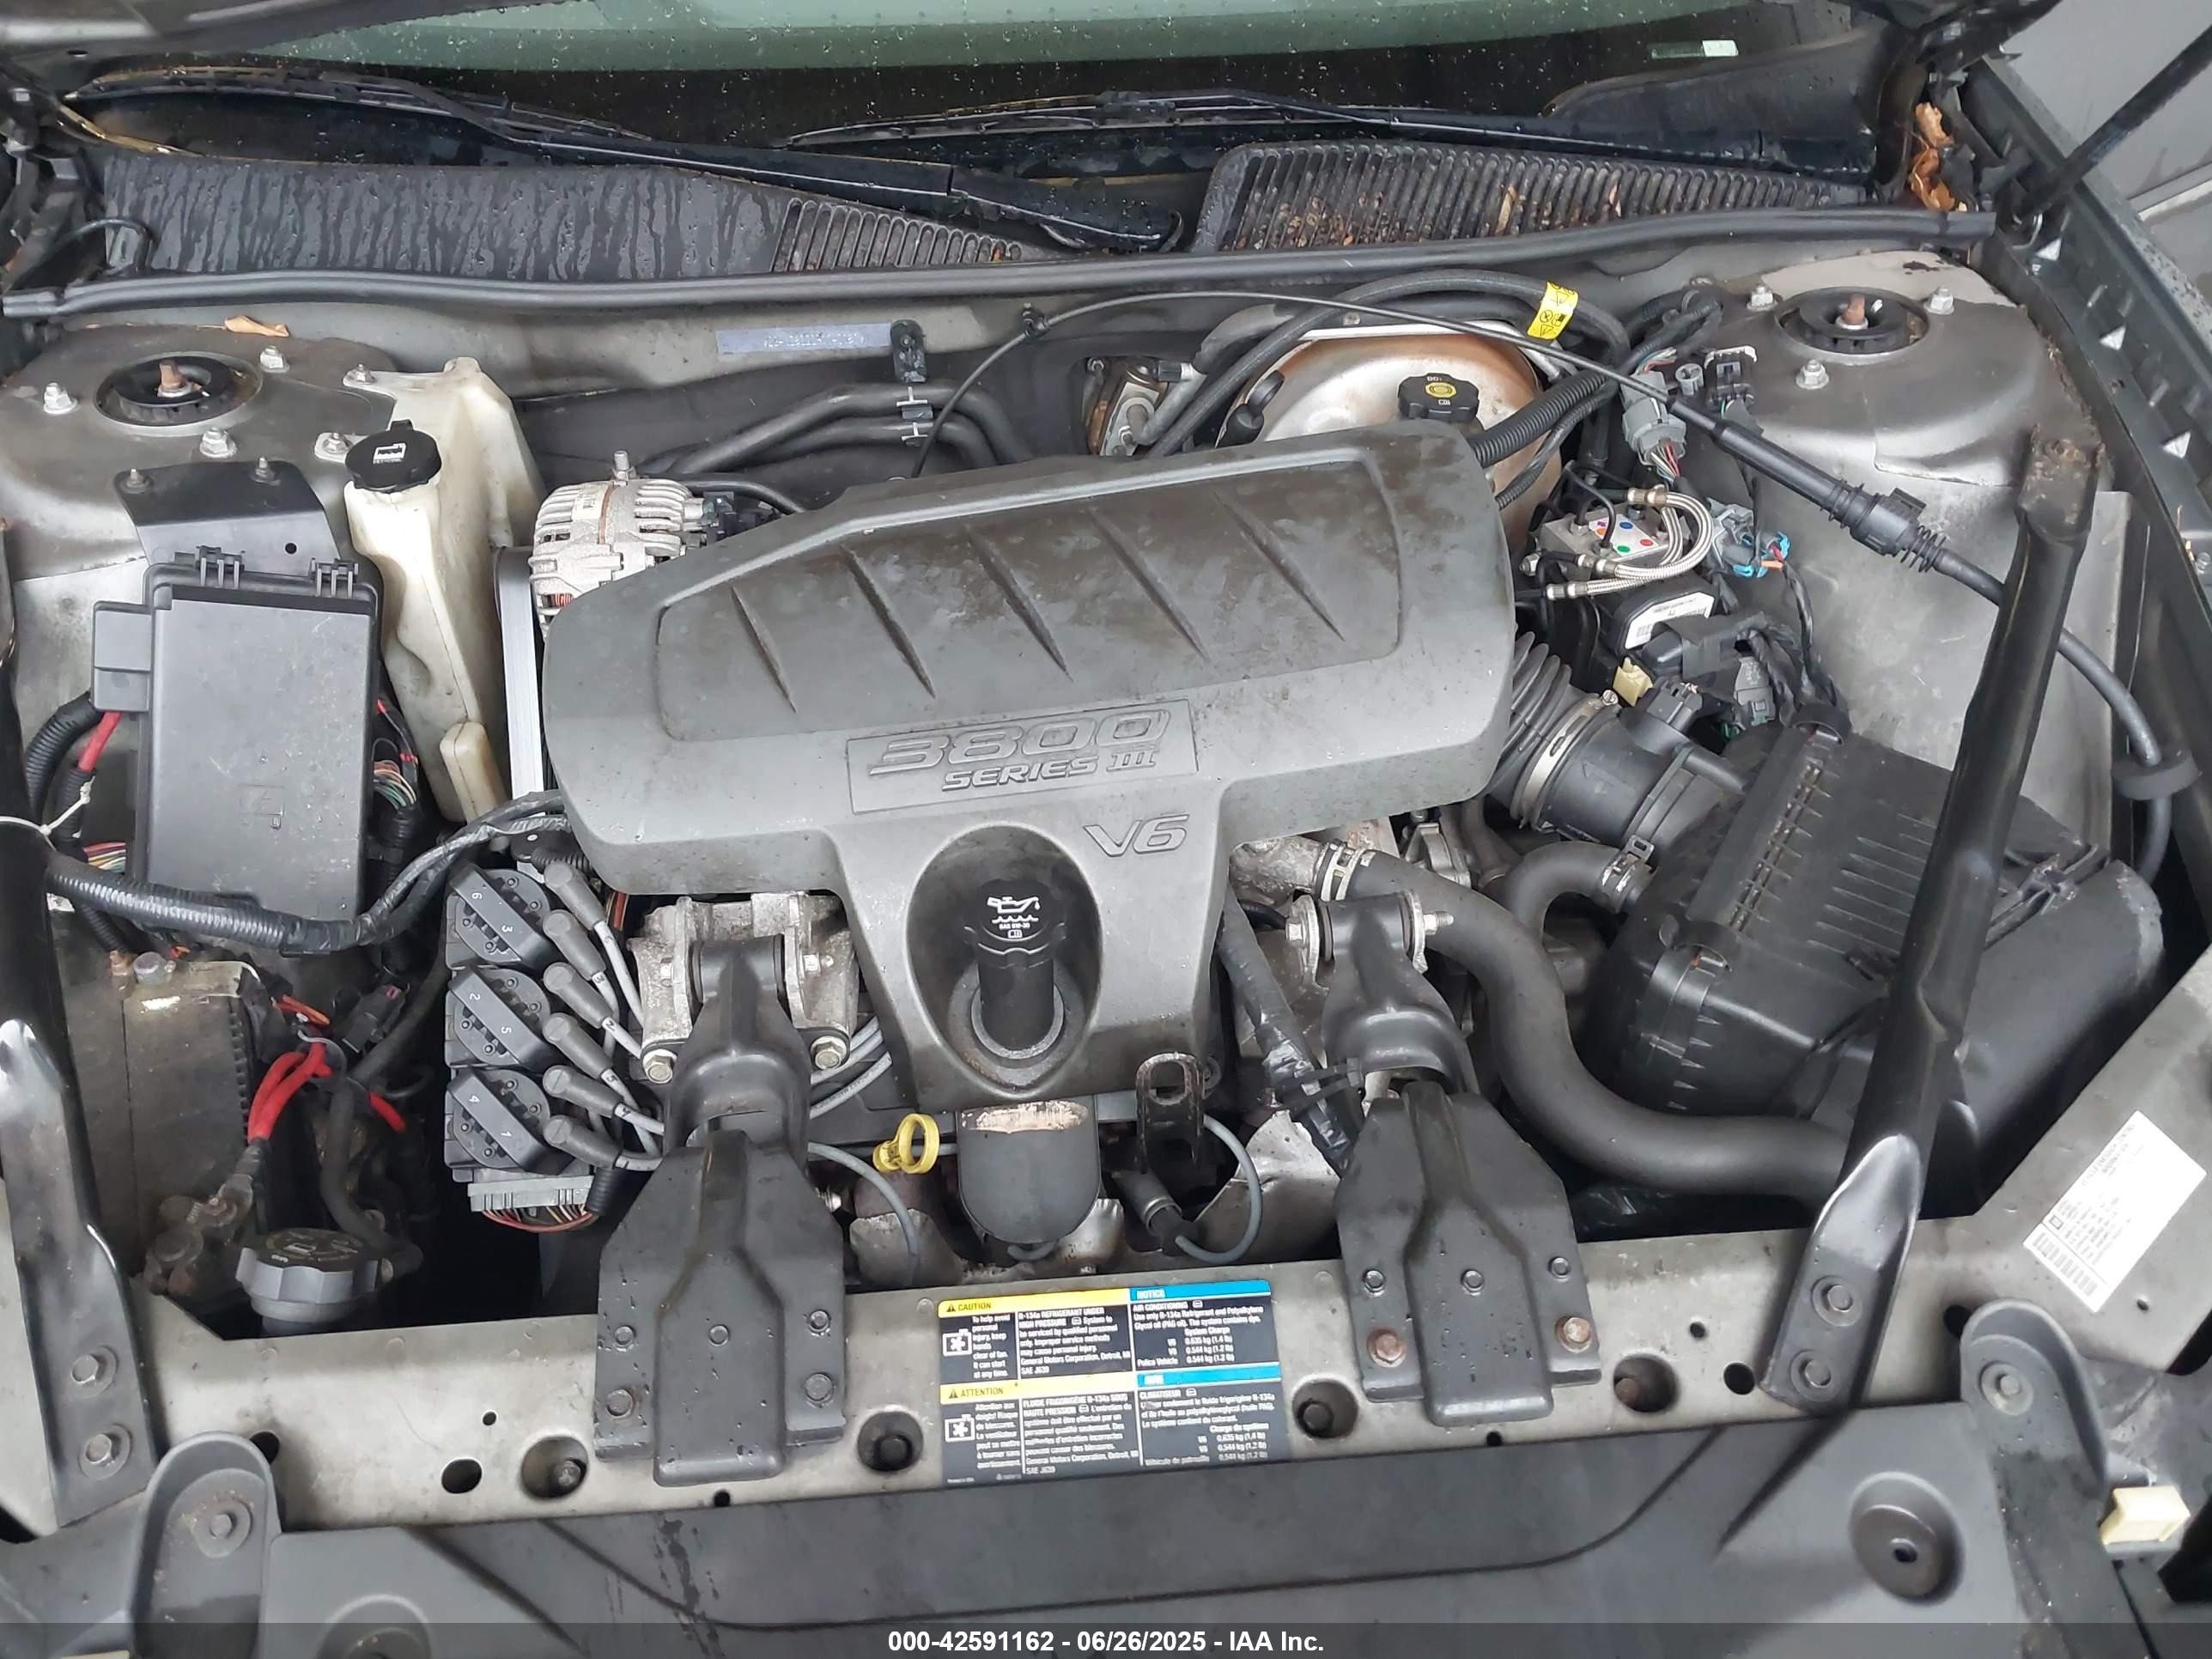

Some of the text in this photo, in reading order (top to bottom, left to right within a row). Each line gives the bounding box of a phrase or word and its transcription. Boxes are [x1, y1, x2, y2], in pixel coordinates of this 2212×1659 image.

[869, 709, 1171, 776] 3800
[941, 750, 1158, 791] SERIES III
[1083, 813, 1190, 858] V6
[957, 1302, 991, 1310] CAUTION
[1137, 1289, 1164, 1298] NOTICE
[960, 1387, 1003, 1396] ATTENTION
